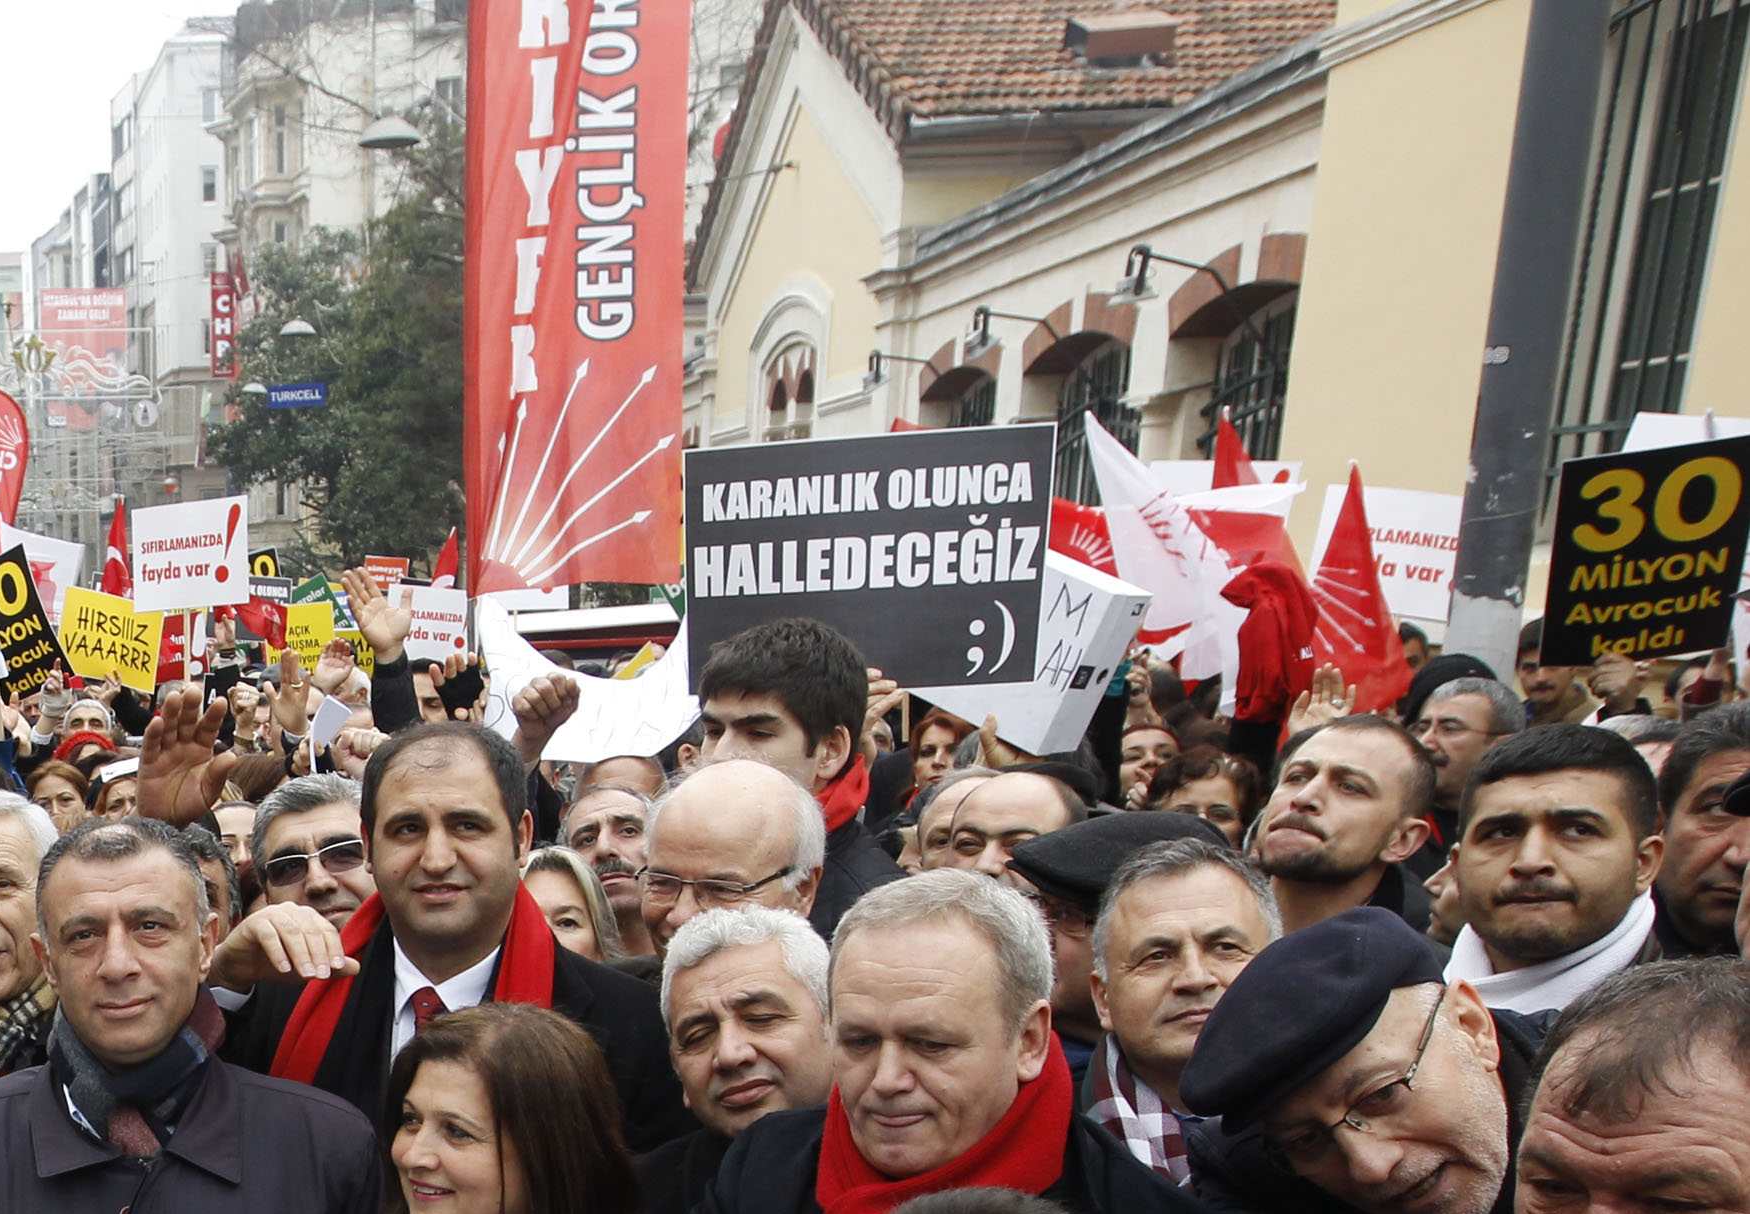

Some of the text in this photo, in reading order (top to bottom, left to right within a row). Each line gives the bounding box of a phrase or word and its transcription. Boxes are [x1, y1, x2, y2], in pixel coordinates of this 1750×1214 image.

[564, 85, 648, 342] GENÇLİK
[214, 294, 232, 358] CHP
[270, 388, 322, 403] TURKCELL
[701, 461, 1033, 523] KARANLIK OLUNCA
[1571, 455, 1744, 553] 30
[140, 533, 224, 554] SIFIRLAMANIZDA
[692, 513, 1043, 599] HALLEDECEĞİZ
[141, 561, 211, 586] fayda var
[1406, 564, 1444, 583] var
[1569, 546, 1730, 592] MİLYON
[1564, 585, 1722, 627] Avrocuk
[435, 630, 452, 642] var
[1590, 624, 1685, 658] kaldı
